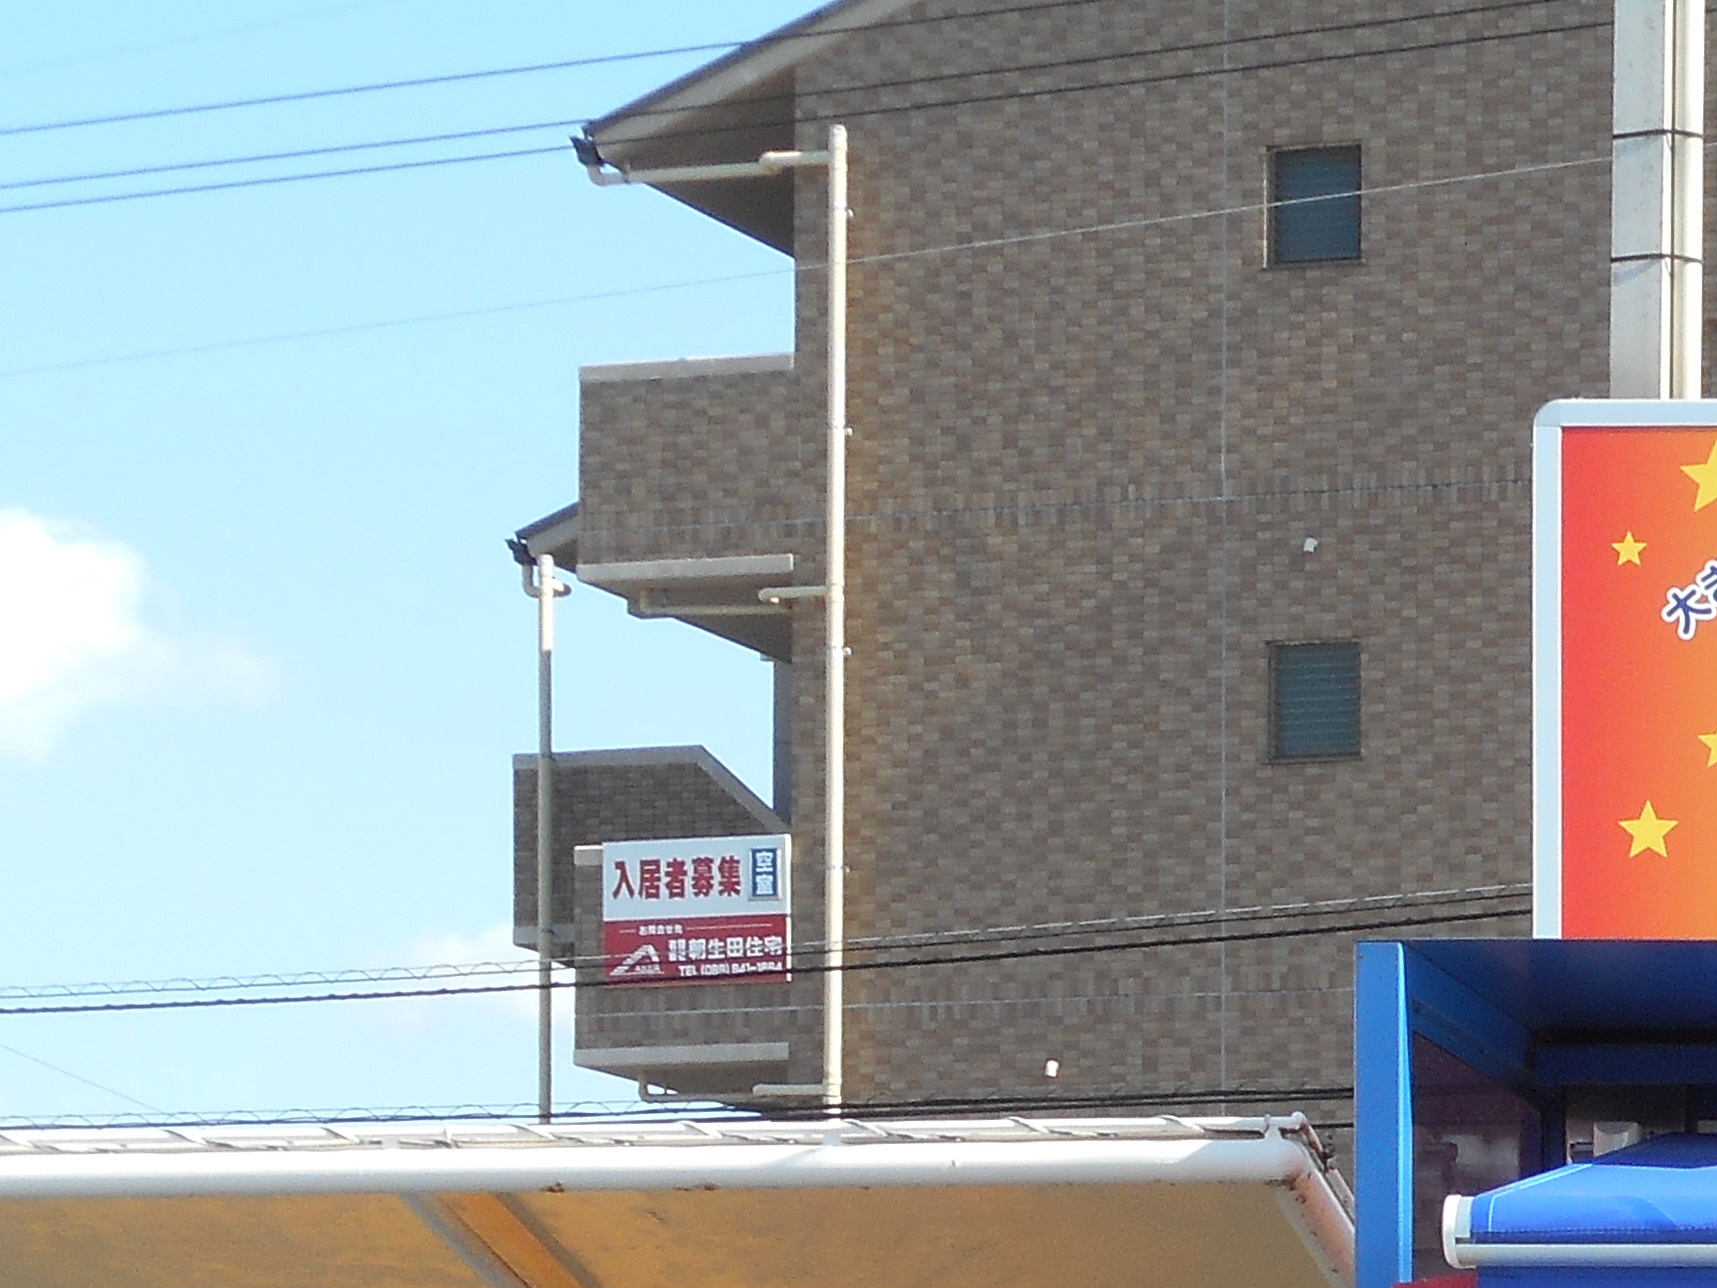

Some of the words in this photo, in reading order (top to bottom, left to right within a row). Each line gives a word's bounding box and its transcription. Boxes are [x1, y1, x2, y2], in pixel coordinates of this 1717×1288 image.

[612, 856, 741, 899] 入居者募集
[754, 850, 775, 895] 空室
